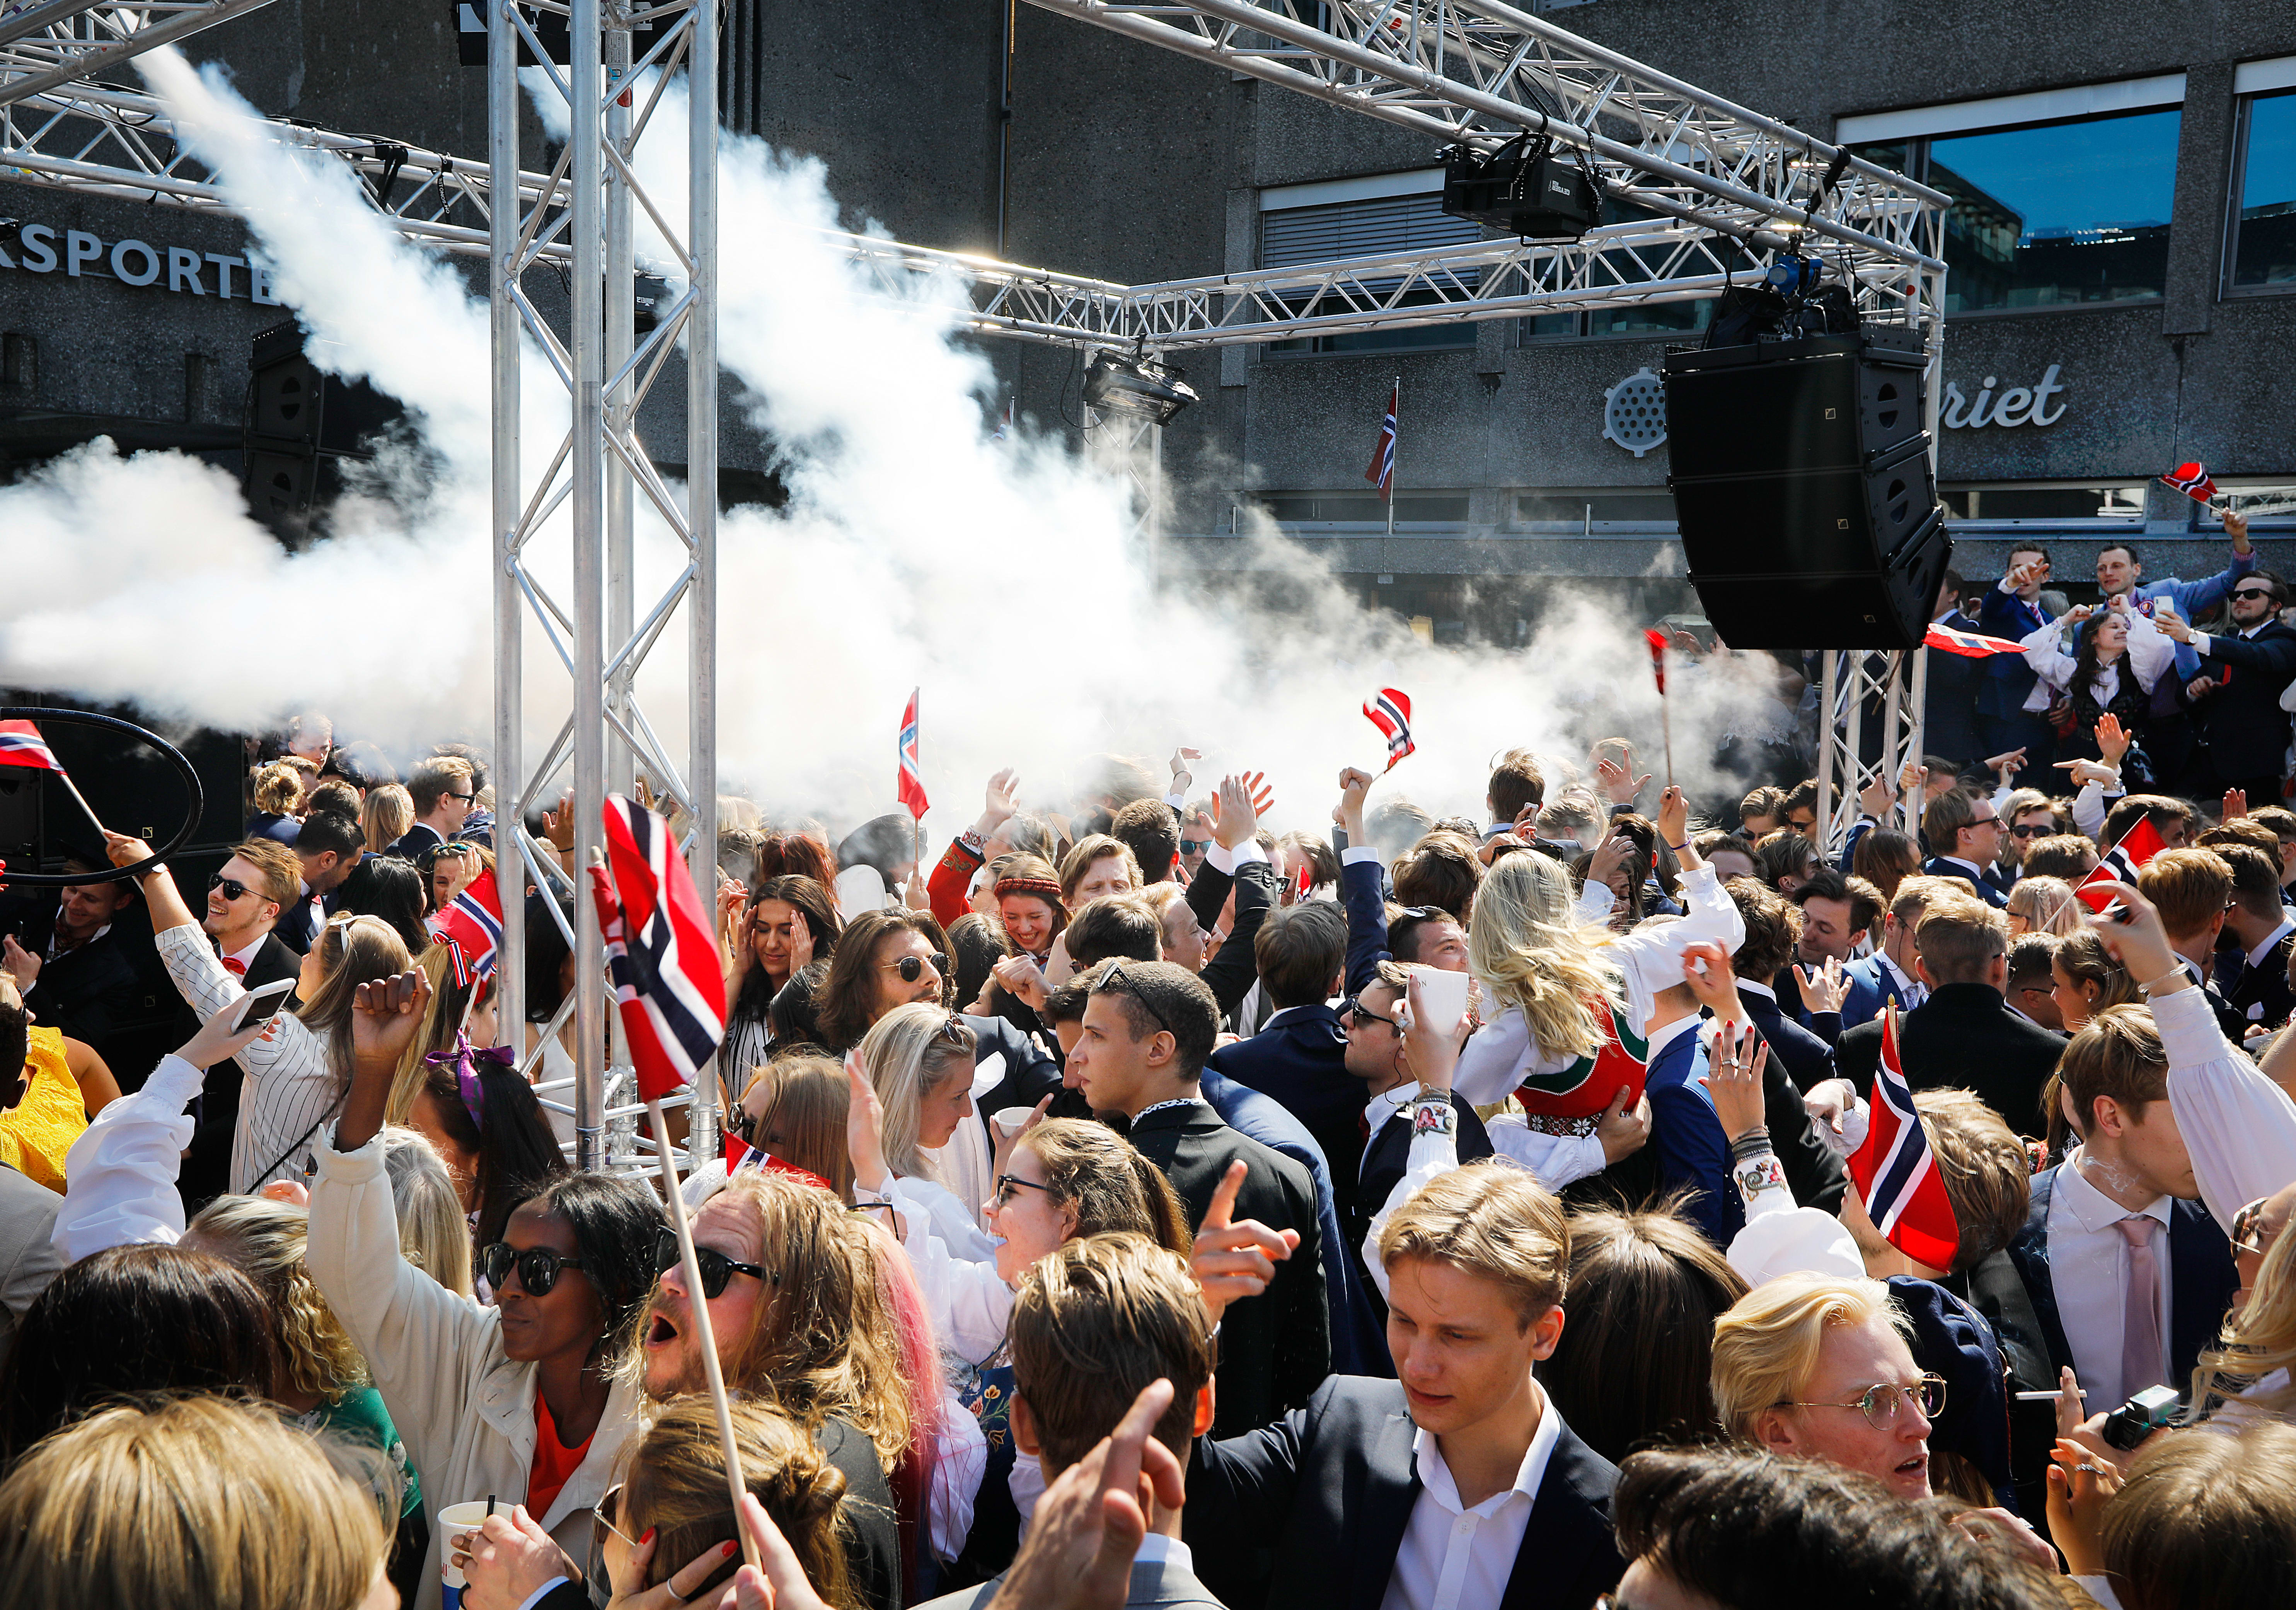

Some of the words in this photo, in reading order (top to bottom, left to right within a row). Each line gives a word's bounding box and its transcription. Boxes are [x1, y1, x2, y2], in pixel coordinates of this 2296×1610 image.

[1551, 184, 1570, 196] GEYSER
[0, 223, 281, 306] SPORTE
[1939, 364, 2067, 429] riet
